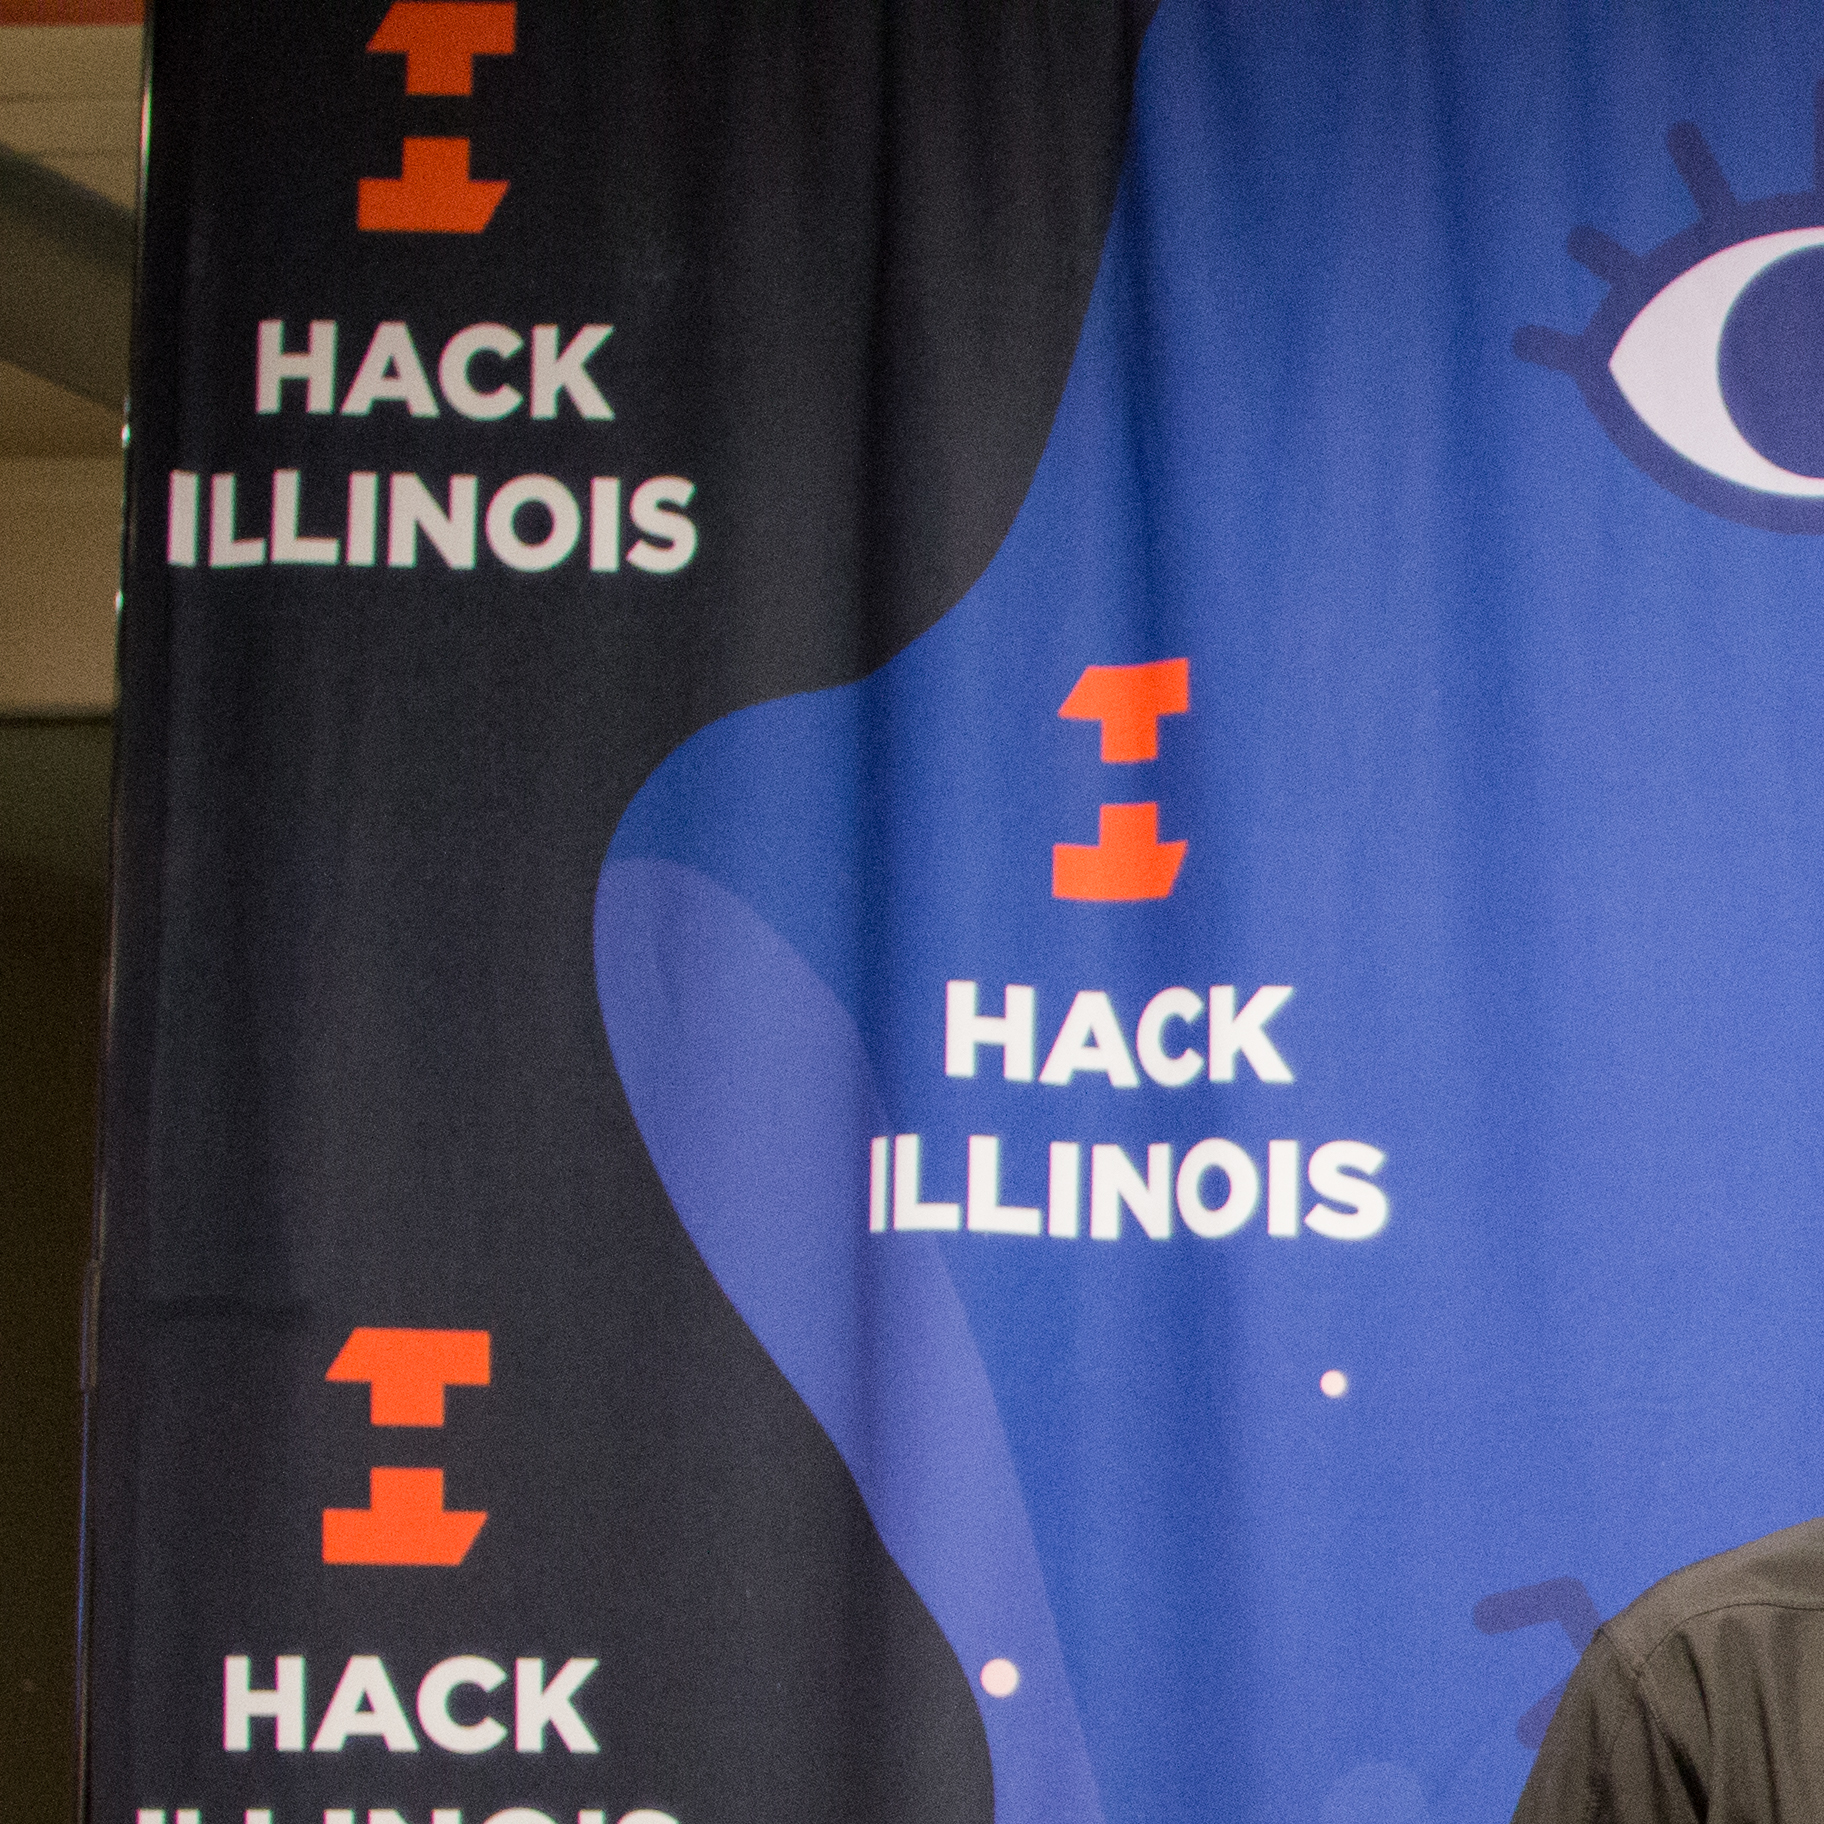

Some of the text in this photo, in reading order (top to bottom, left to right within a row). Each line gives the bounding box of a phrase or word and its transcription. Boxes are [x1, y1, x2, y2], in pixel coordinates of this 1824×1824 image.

[258, 321, 613, 420] HACK
[169, 470, 698, 573] ILLINOIS
[945, 979, 1295, 1089] HACK
[870, 1133, 1391, 1242] ILLINOIS
[225, 1654, 600, 1755] HACK
